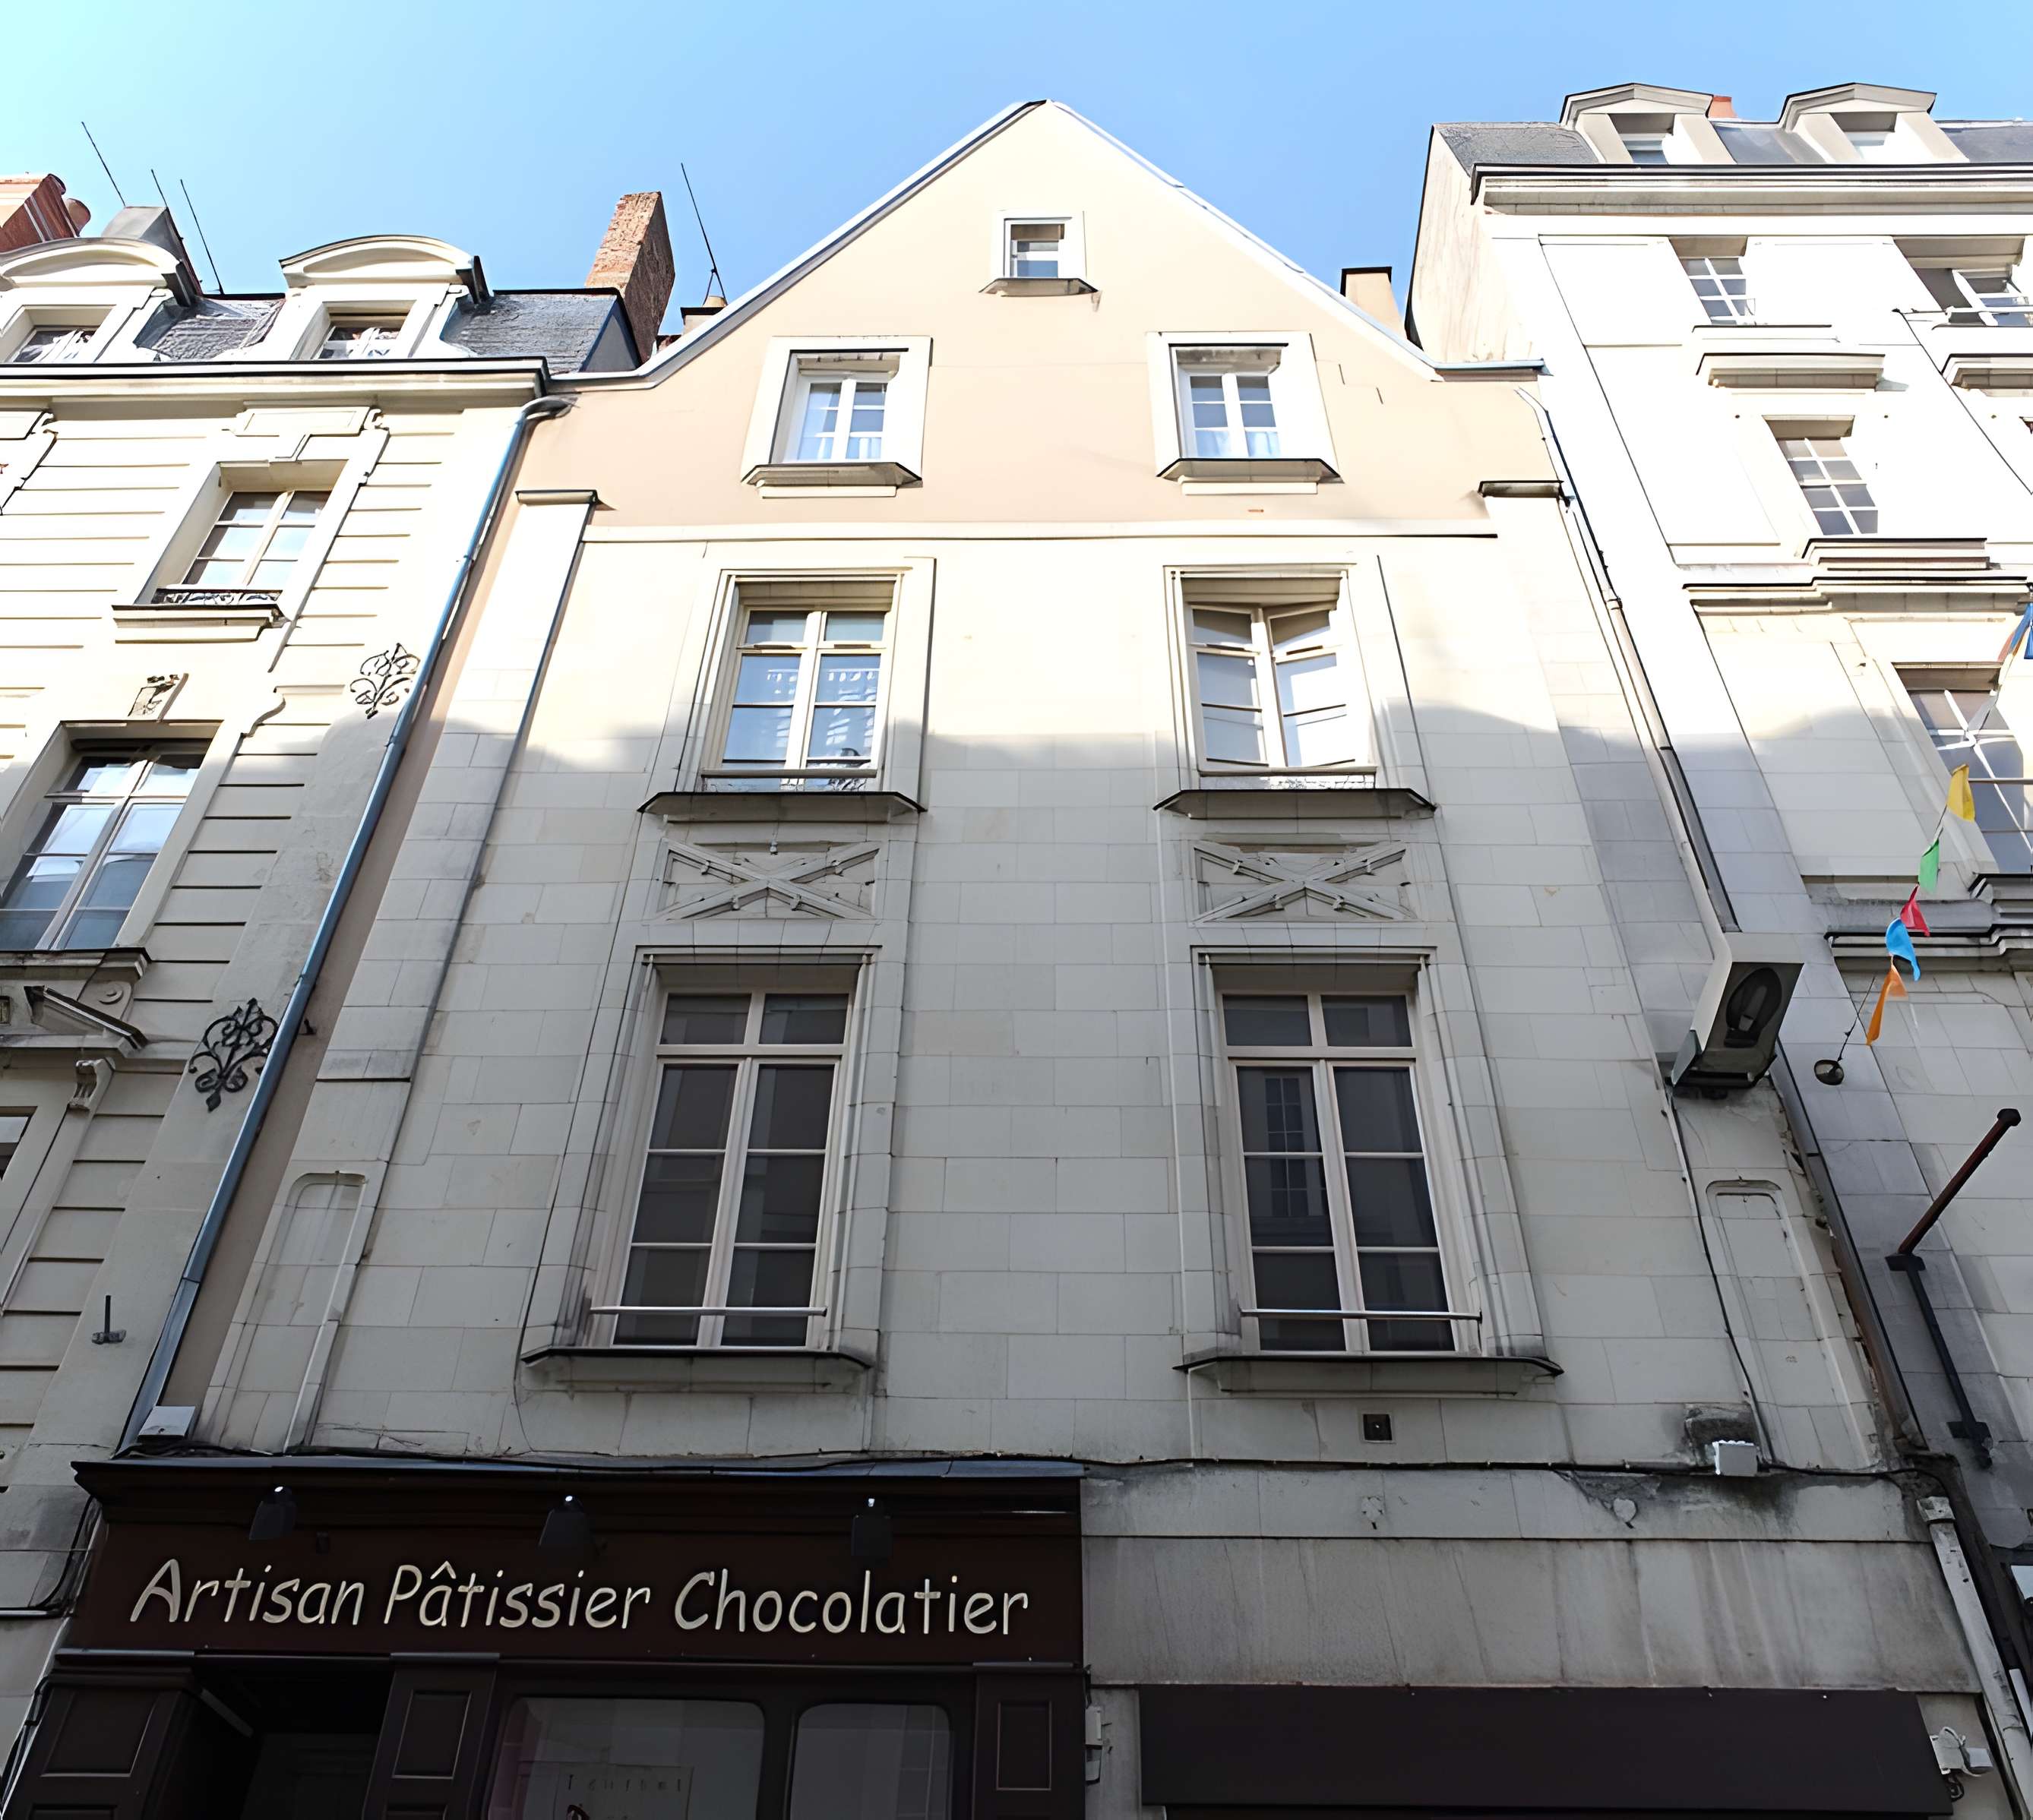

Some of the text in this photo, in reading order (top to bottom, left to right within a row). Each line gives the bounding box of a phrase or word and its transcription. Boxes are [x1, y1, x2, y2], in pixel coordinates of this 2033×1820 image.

[130, 1559, 1029, 1635] Artisan Pâtissier Chocolatier
